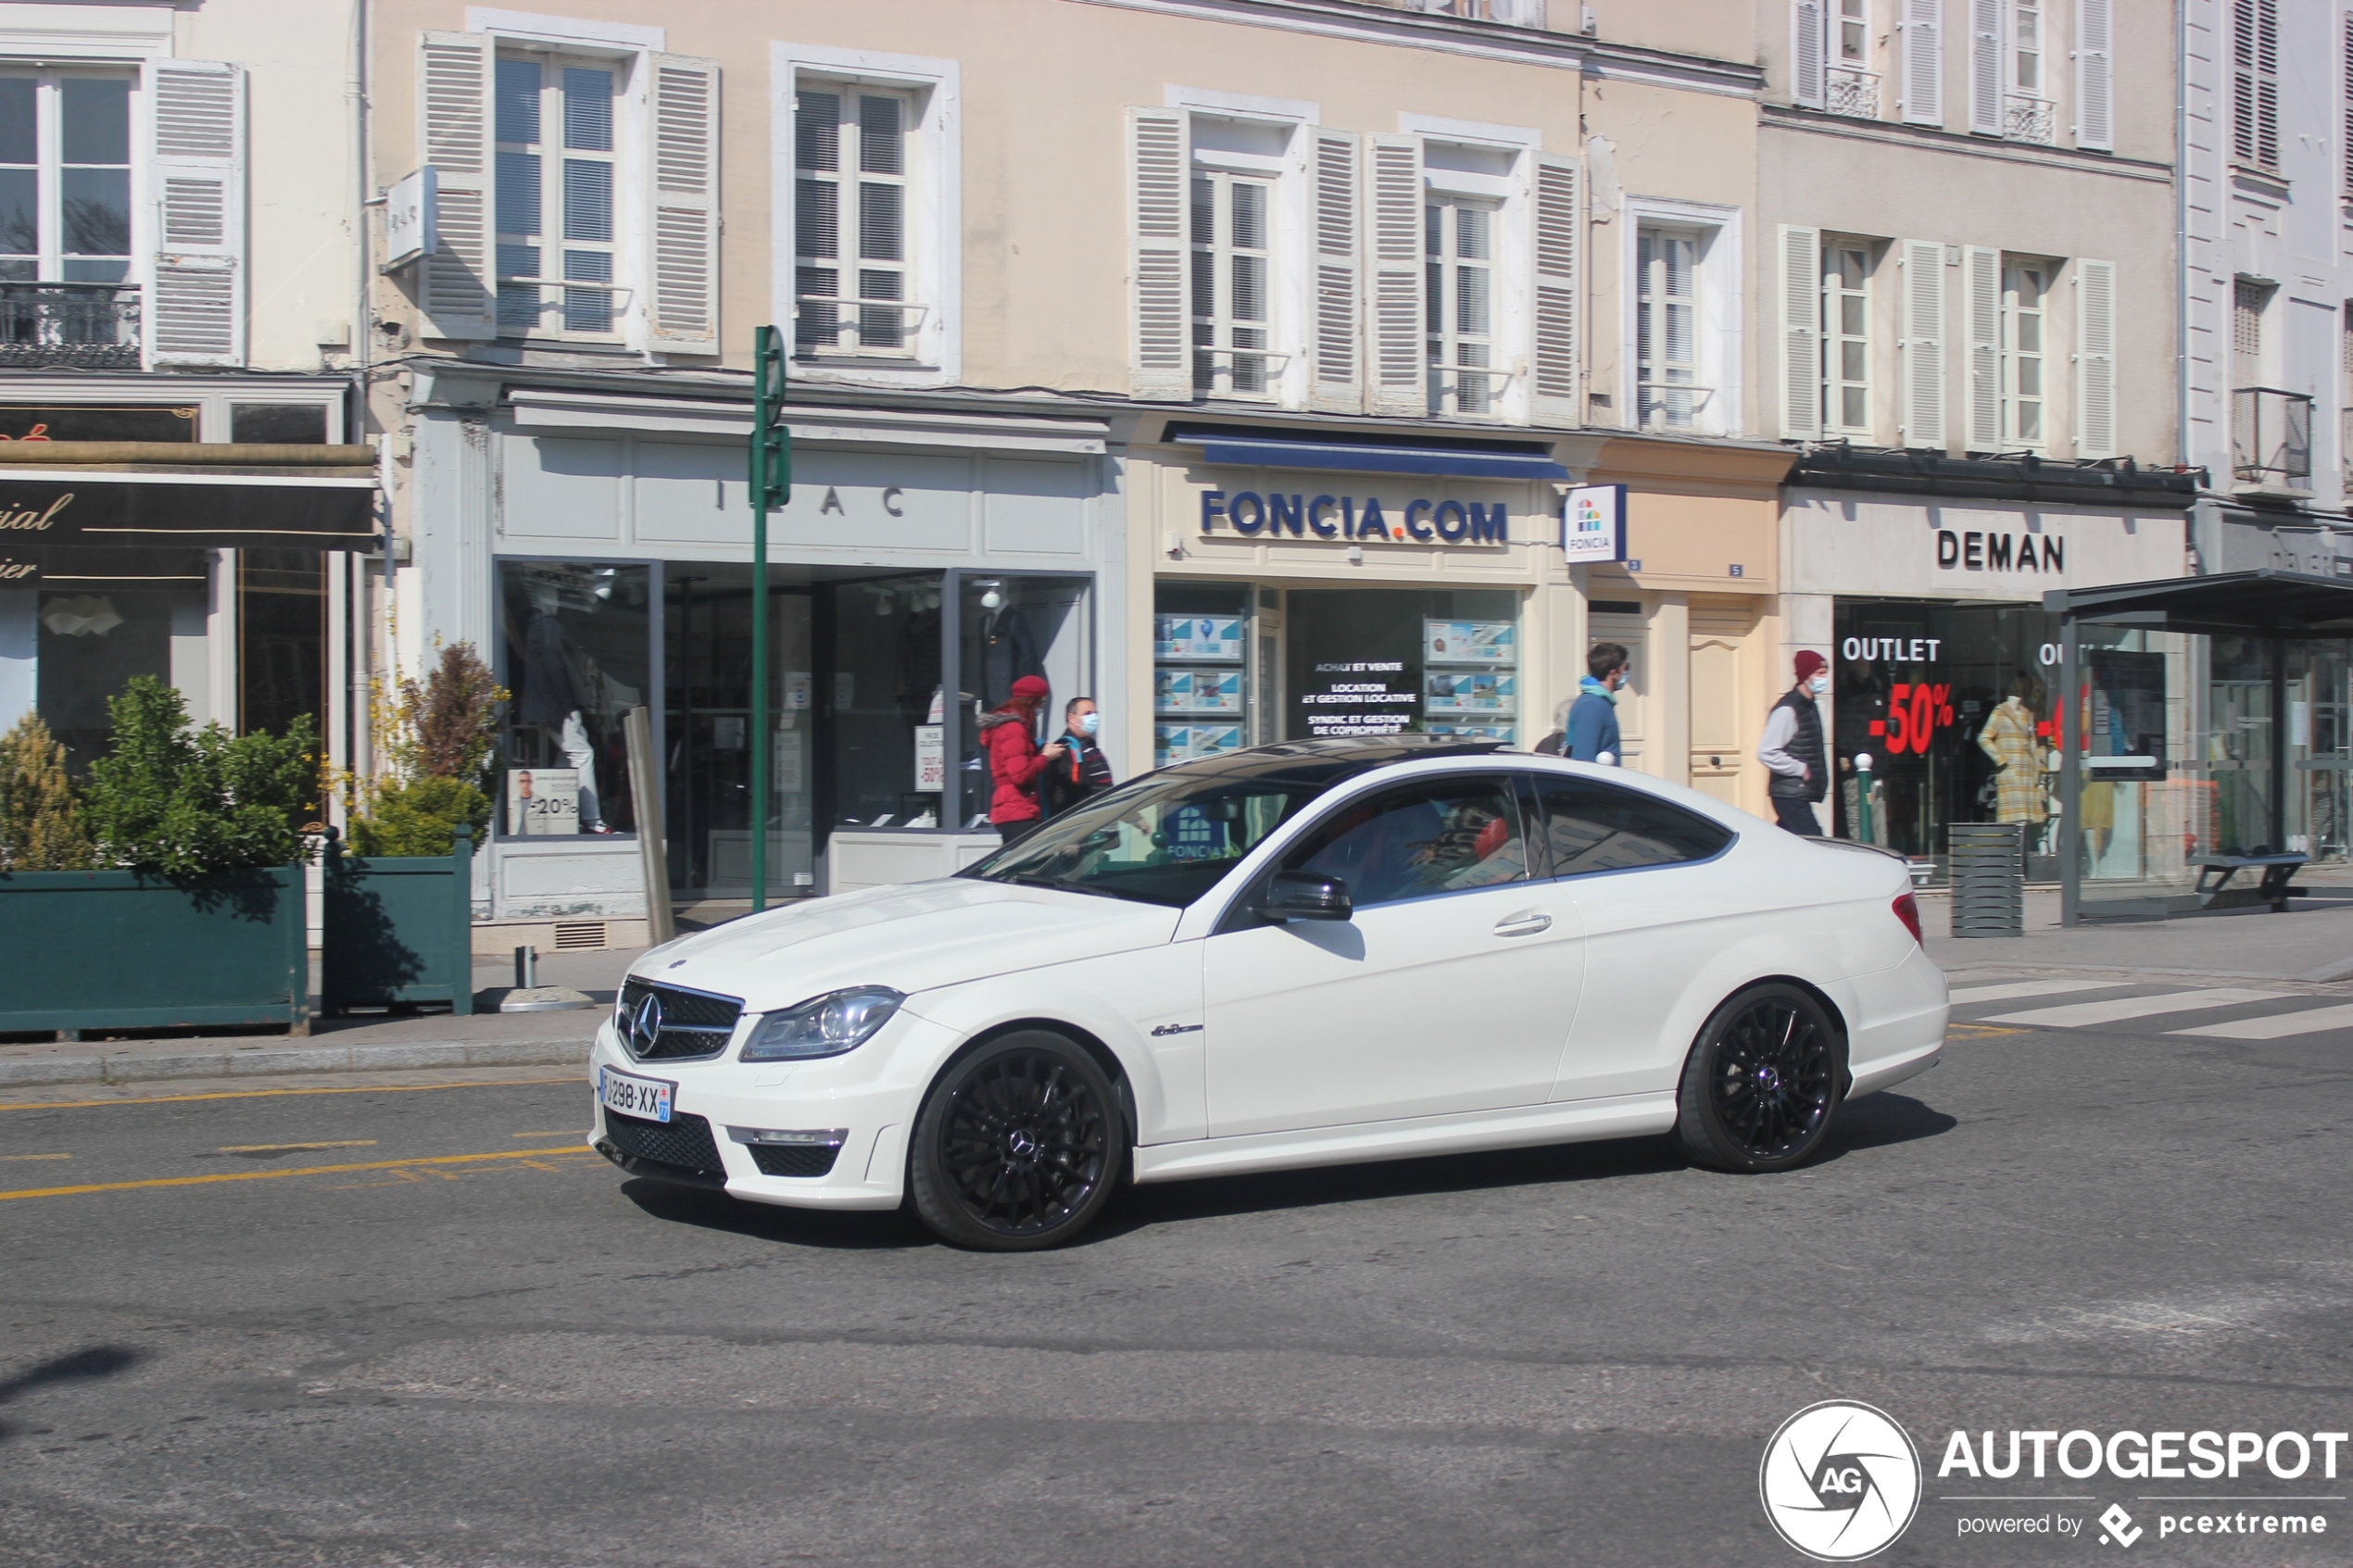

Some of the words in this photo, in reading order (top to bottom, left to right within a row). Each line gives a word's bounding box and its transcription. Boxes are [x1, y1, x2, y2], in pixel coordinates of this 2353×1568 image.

[716, 475, 904, 518] IAC
[0, 493, 75, 531] ial
[1201, 490, 1507, 542] FONCIA.COM
[1569, 537, 1611, 550] FONCIA
[1938, 530, 2063, 574] DEMAN
[1843, 636, 1941, 662] OUTLET
[1353, 662, 1366, 671] ET
[1367, 662, 1403, 671] VENTE
[1331, 684, 1387, 693] LOCATION
[1316, 694, 1364, 703] GESTION
[1365, 694, 1416, 703] LOCATIVE
[1307, 716, 1347, 724] SYNDIC
[1348, 715, 1362, 723] ET
[1363, 714, 1410, 723] GESTION
[1869, 683, 1954, 754] -50%
[1313, 726, 1329, 734] DE
[530, 798, 579, 814] -20%
